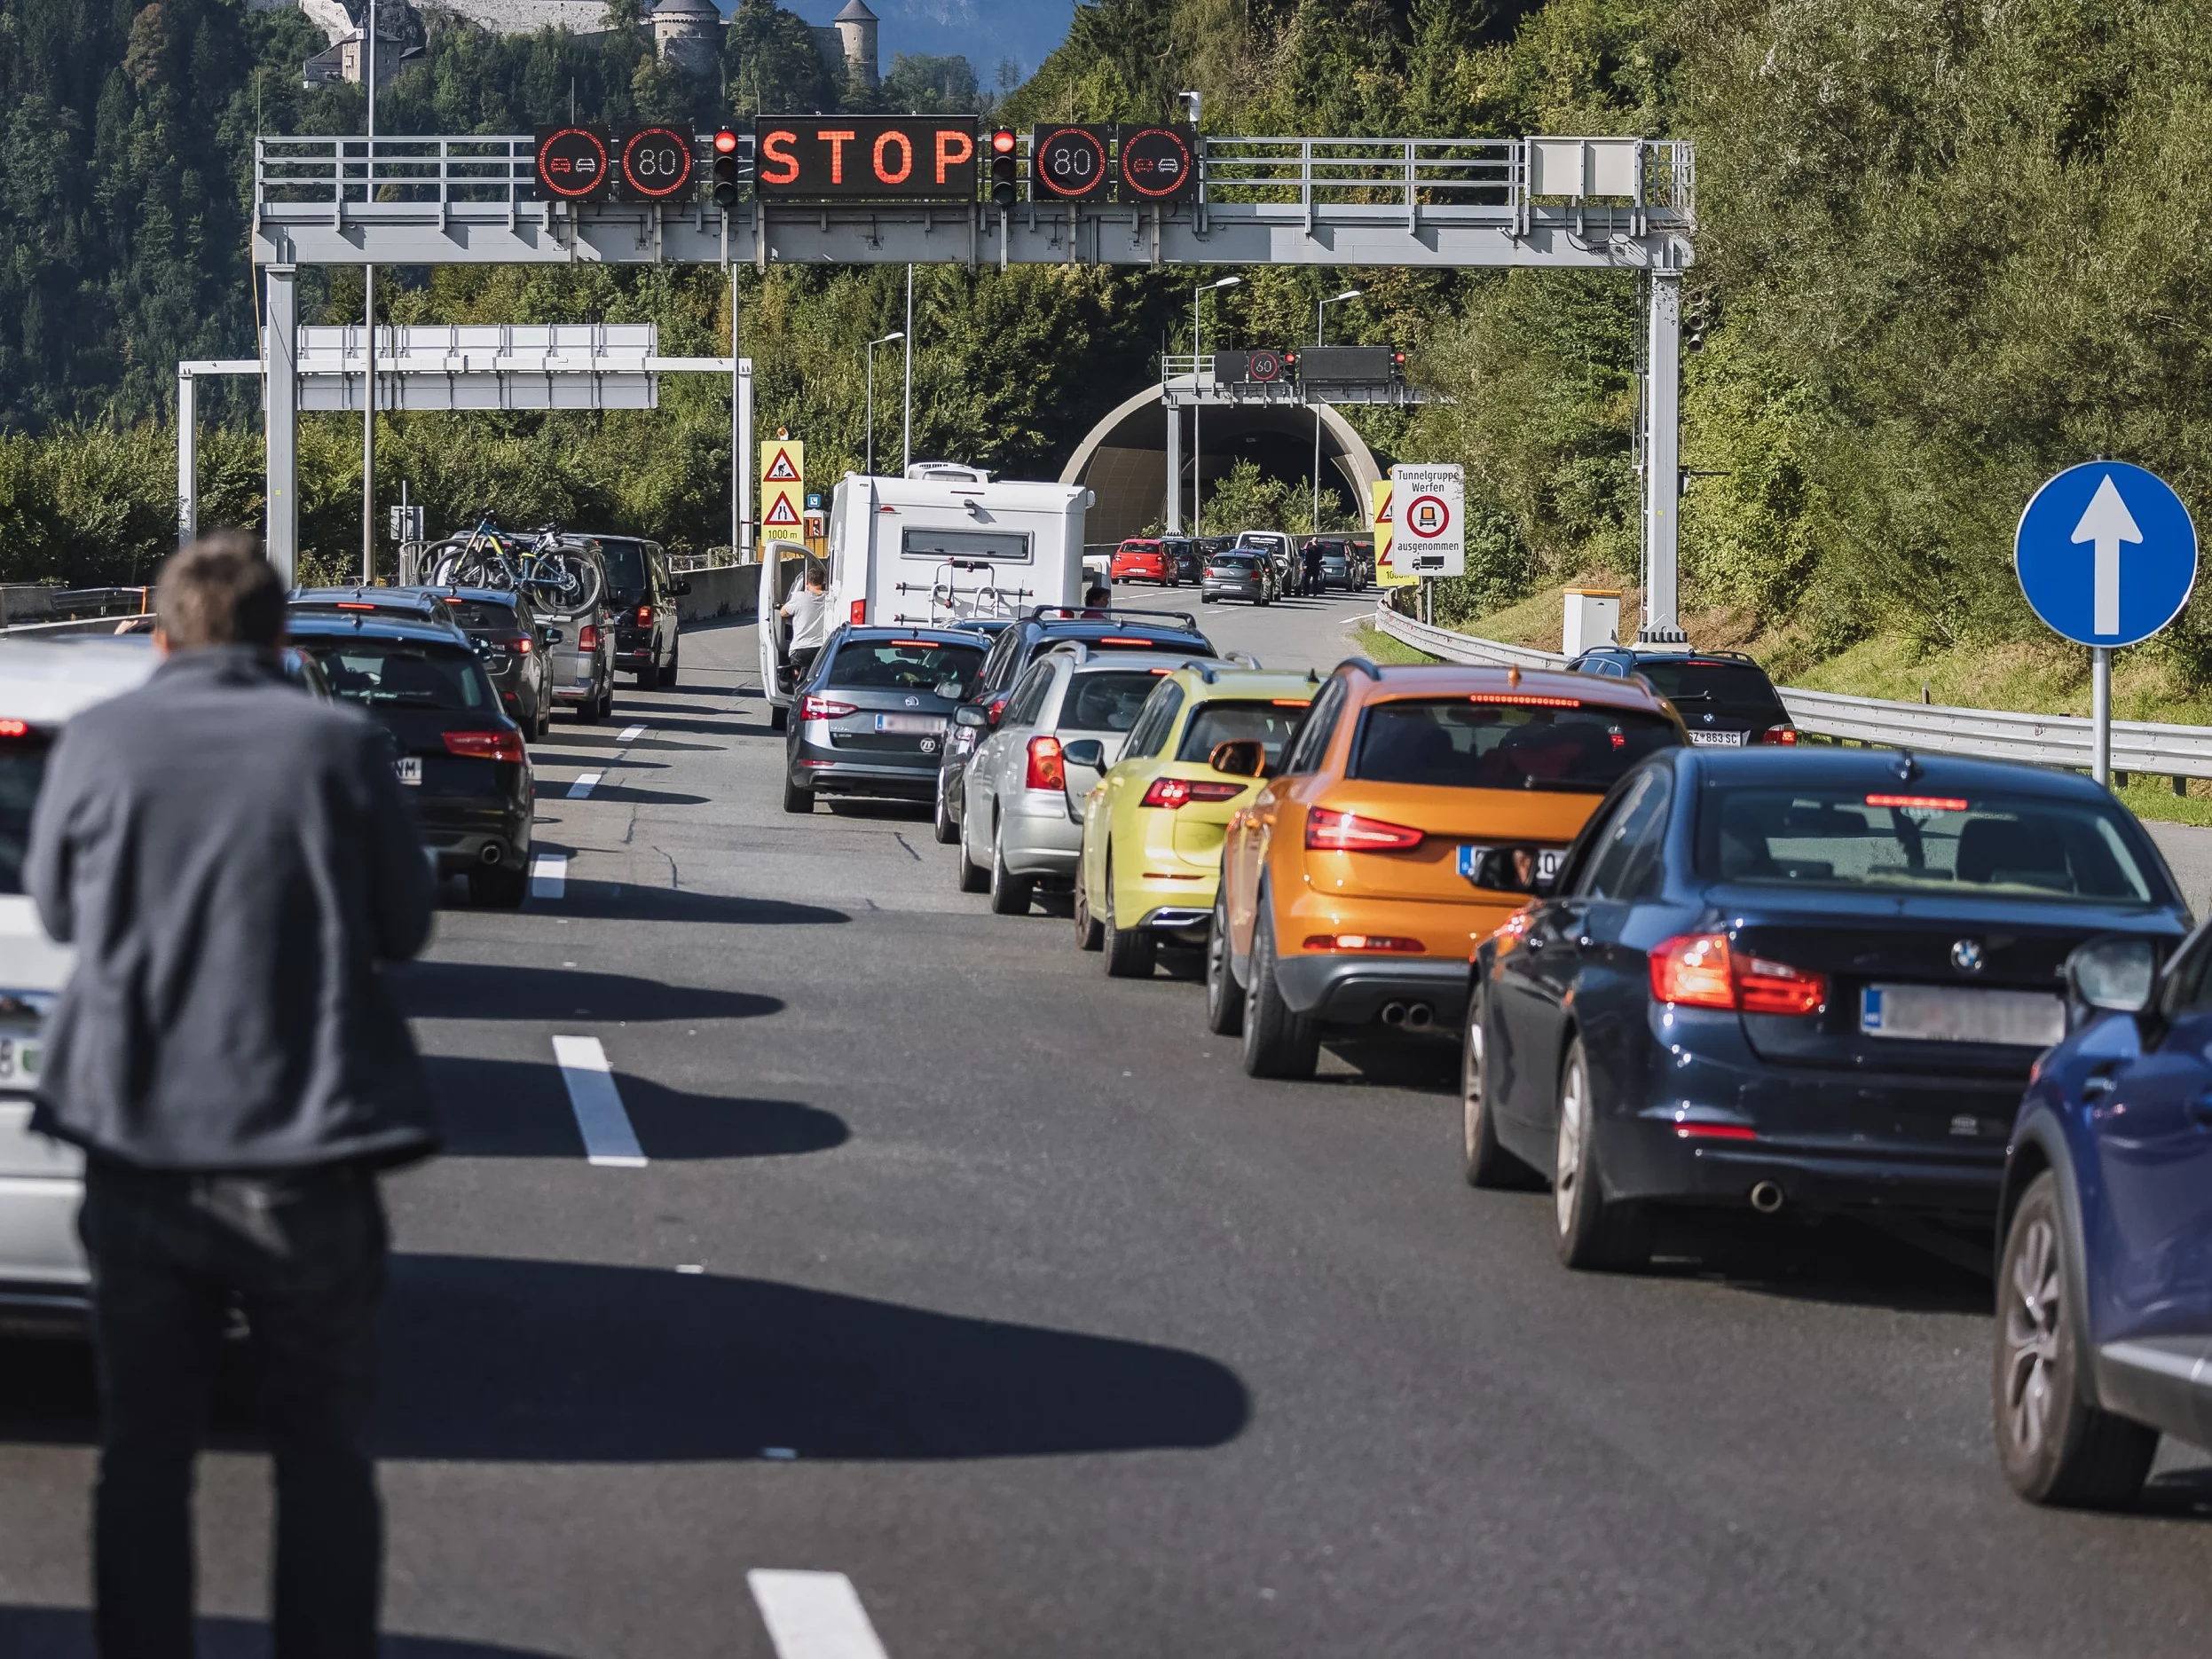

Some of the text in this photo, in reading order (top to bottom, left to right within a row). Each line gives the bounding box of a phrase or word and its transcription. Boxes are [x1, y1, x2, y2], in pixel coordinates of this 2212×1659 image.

[639, 148, 676, 176] 80
[760, 130, 973, 185] STOP
[1054, 148, 1090, 176] 80
[1256, 360, 1272, 373] 60
[1397, 469, 1460, 483] Tunnelgruppe
[1412, 482, 1445, 492] Werfen
[768, 529, 788, 539] 1000
[1397, 541, 1460, 553] ausgenommen
[1706, 733, 1723, 743] 863
[1726, 734, 1737, 743] SC
